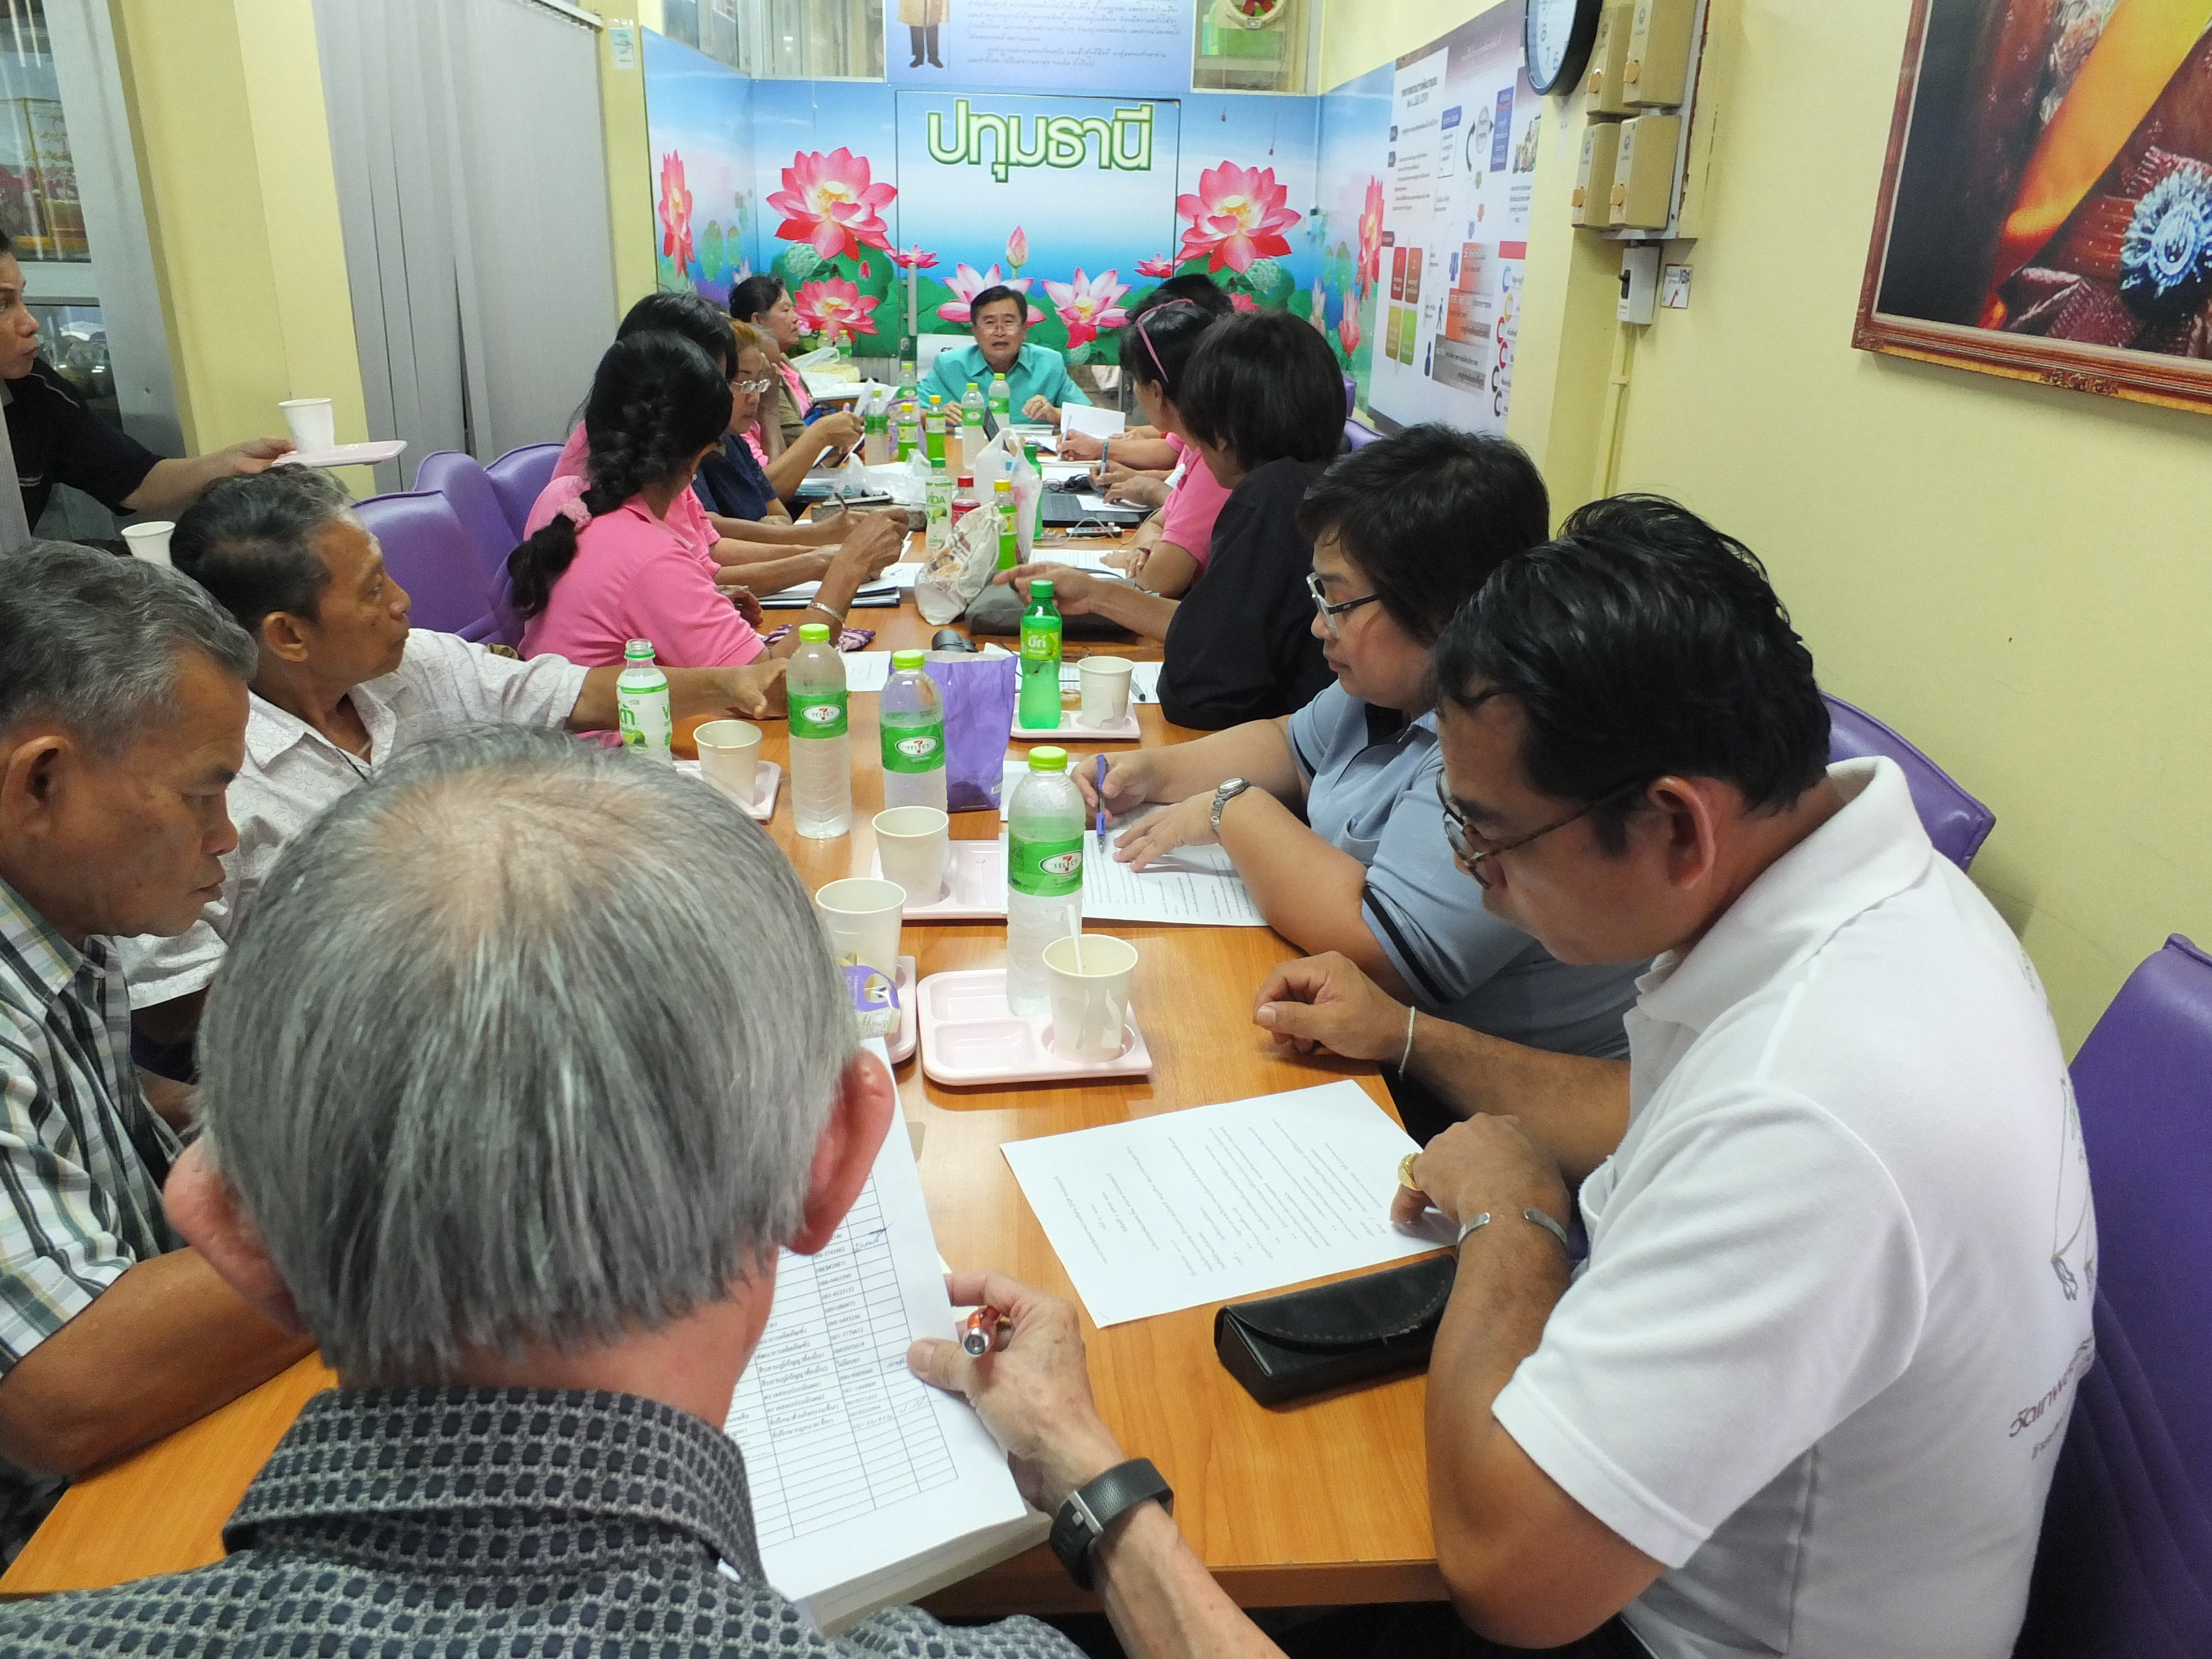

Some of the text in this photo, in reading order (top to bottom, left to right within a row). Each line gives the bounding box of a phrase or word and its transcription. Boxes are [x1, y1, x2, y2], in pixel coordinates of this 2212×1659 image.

[926, 98, 1155, 184] ปทุมธานี
[1054, 859, 1078, 868] SELECT
